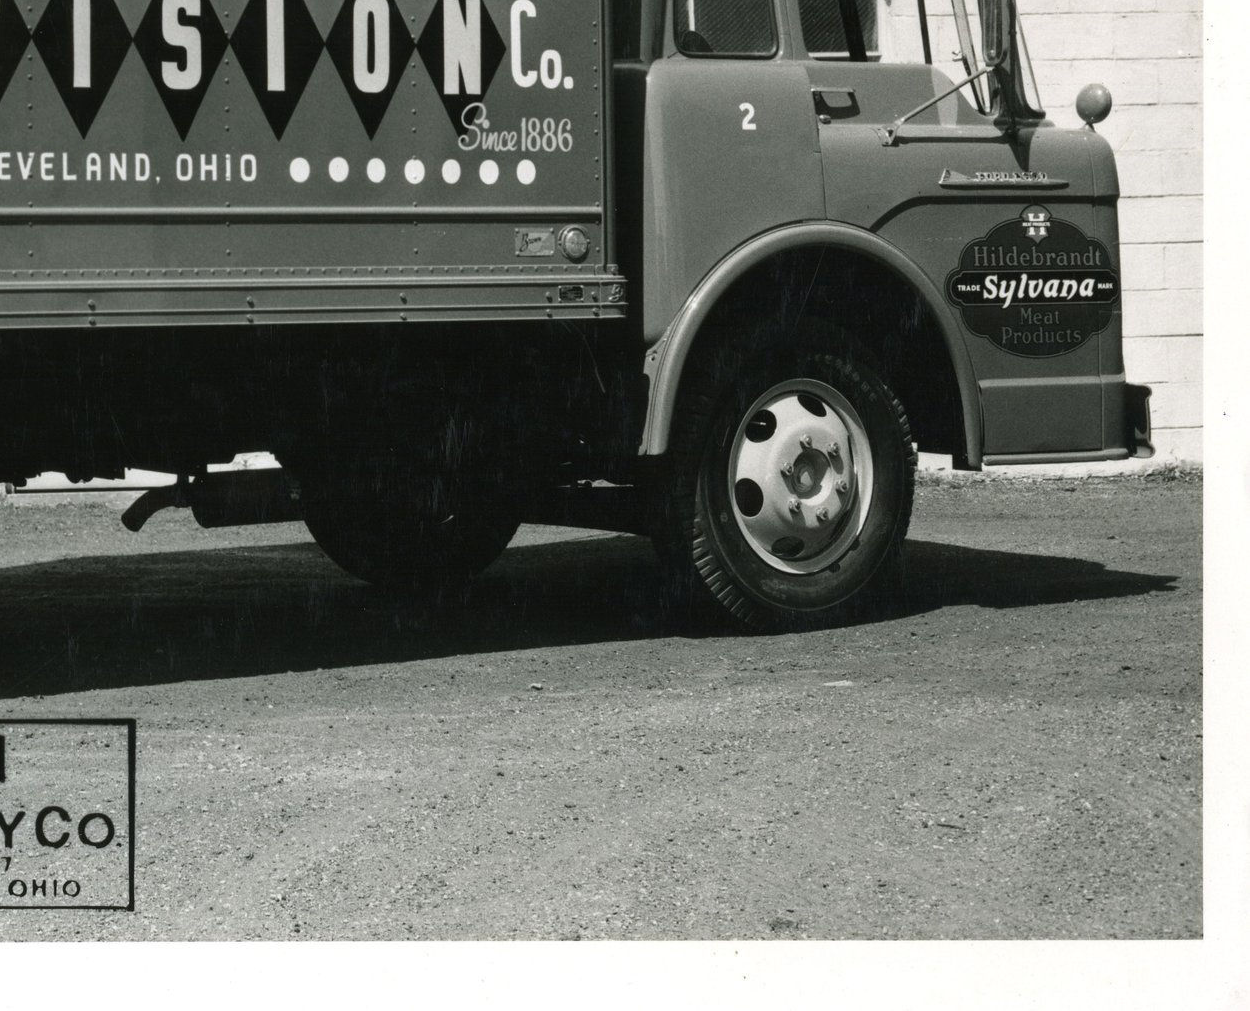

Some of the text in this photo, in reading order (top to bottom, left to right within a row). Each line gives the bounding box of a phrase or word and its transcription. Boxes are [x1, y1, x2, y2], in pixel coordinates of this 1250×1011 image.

[457, 101, 574, 153] Since 1886
[739, 102, 757, 131] 2
[175, 152, 258, 182] OHIO
[973, 245, 1102, 267] Hildebrandt
[957, 284, 981, 292] TRADE
[983, 273, 1095, 309] Sylvana
[1020, 307, 1060, 325] Meat
[1001, 327, 1082, 344] Products
